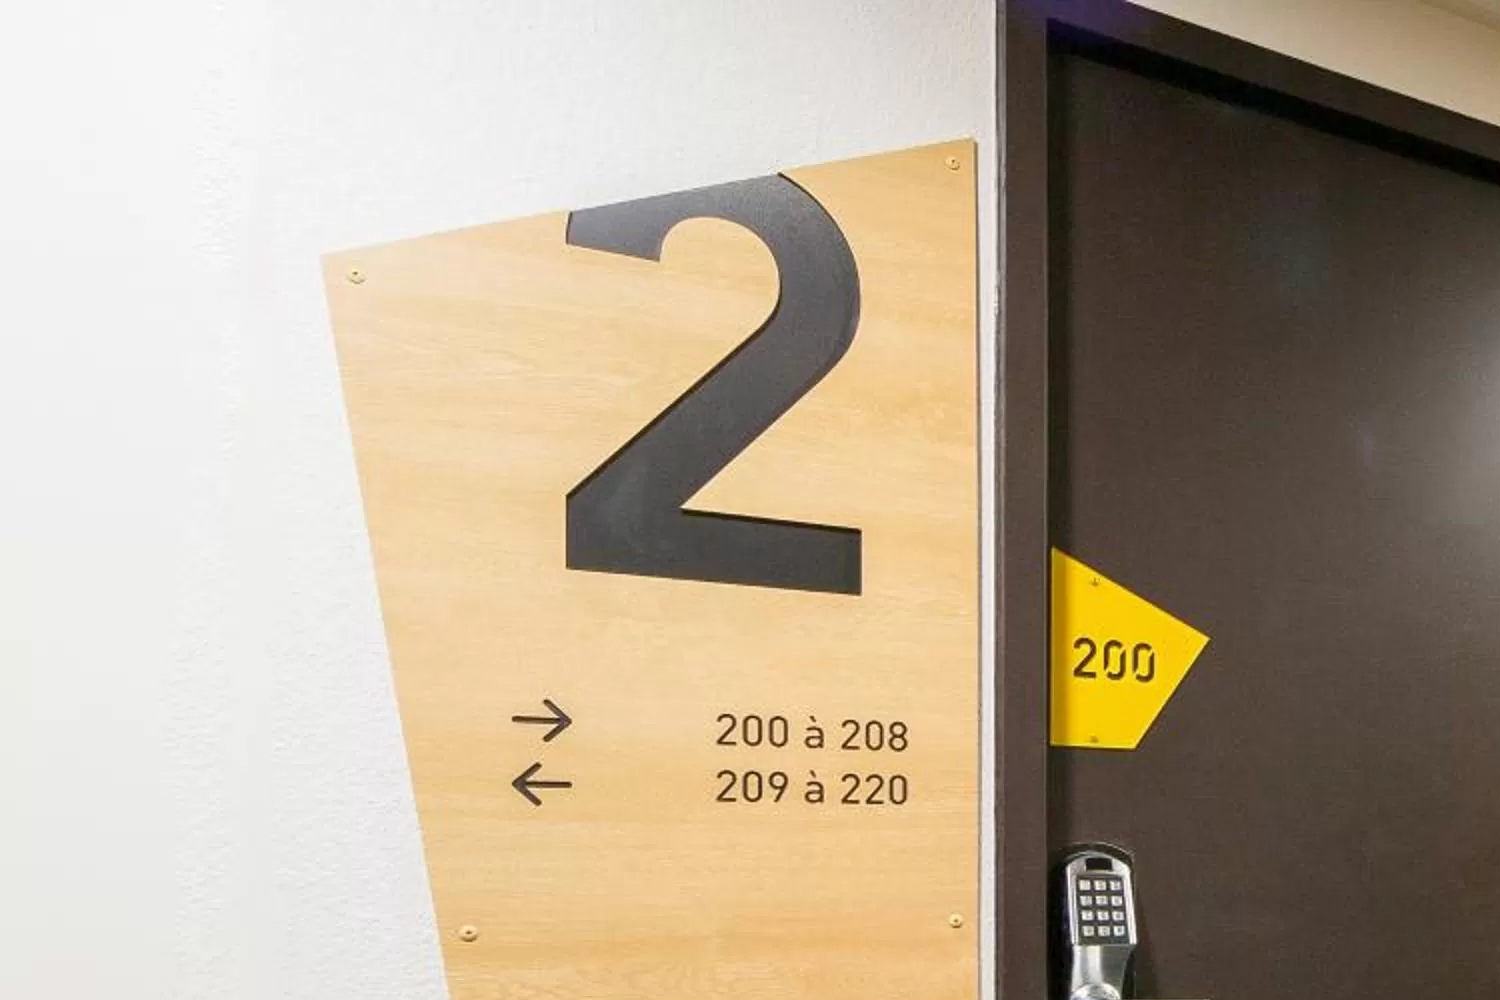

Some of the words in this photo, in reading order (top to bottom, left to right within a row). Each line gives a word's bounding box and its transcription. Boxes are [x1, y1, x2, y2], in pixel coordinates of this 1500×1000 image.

[566, 172, 862, 596] 2
[1072, 636, 1156, 685] 200
[716, 713, 788, 749] 200
[804, 715, 825, 750] à
[841, 719, 909, 753] 208
[716, 769, 789, 803] 209
[804, 769, 825, 805] à
[841, 772, 908, 806] 220
